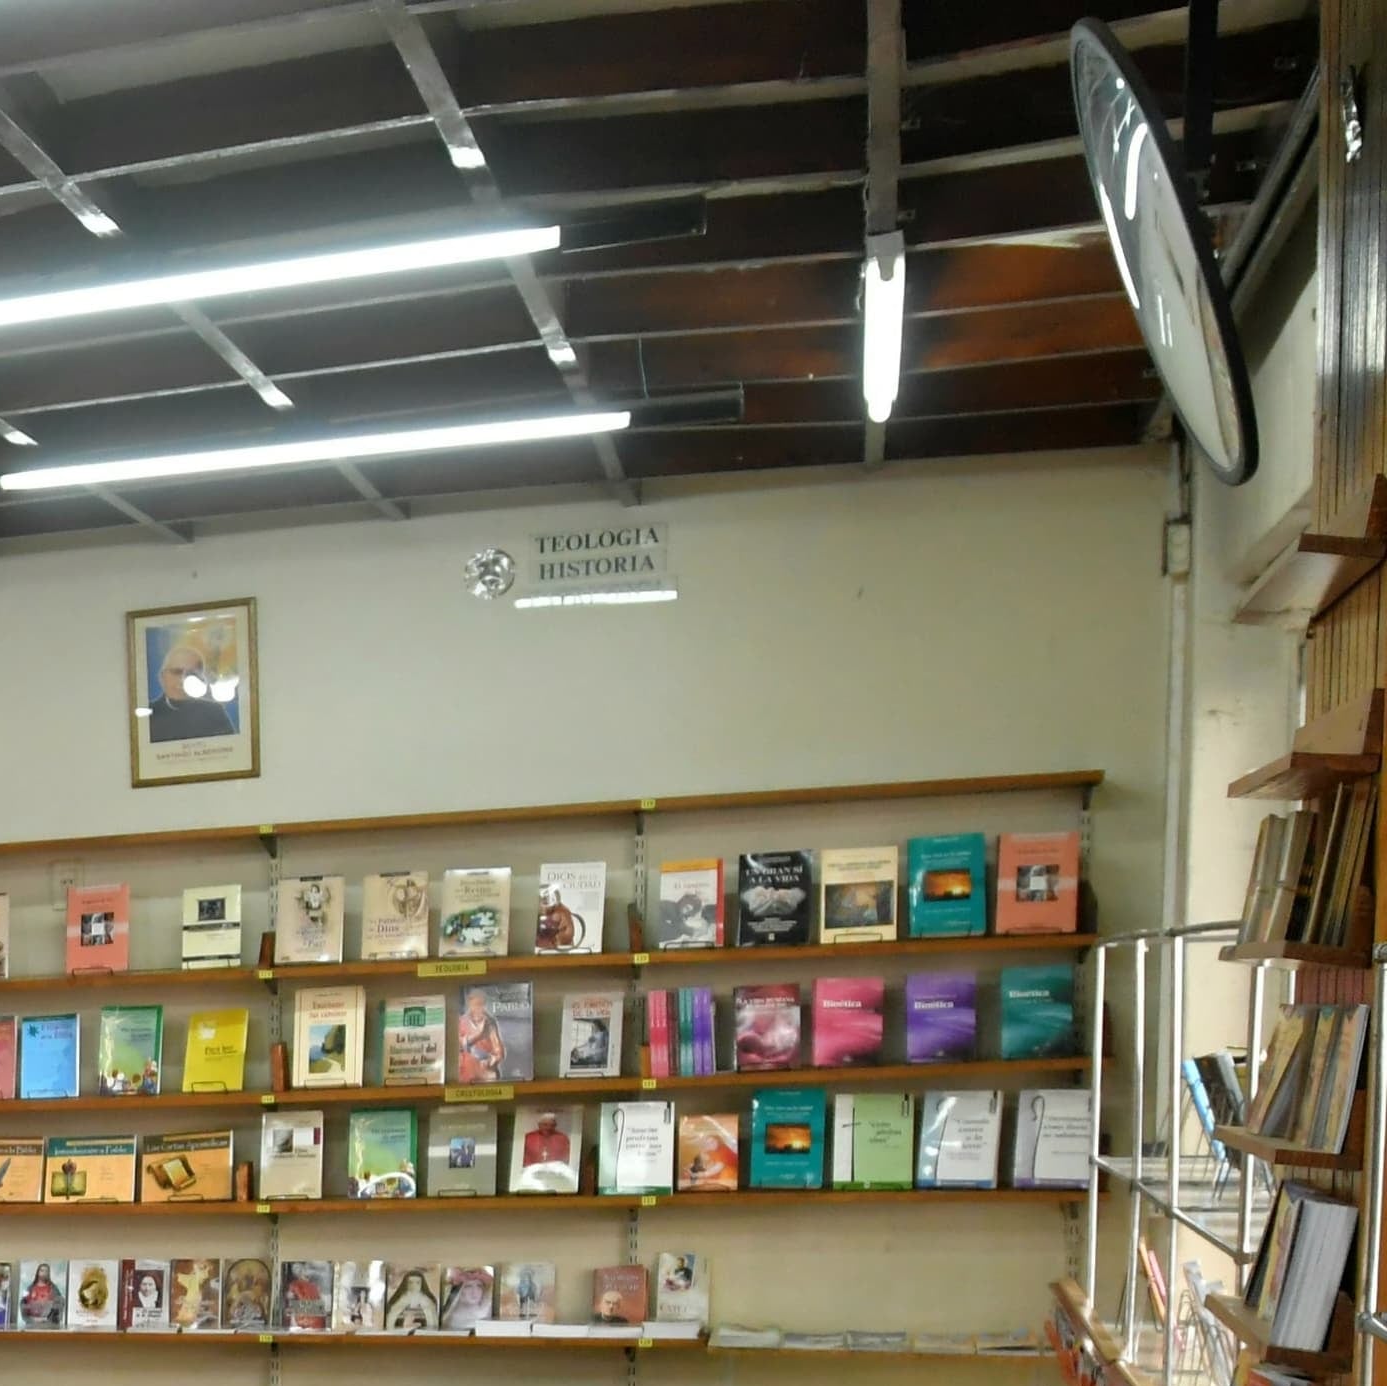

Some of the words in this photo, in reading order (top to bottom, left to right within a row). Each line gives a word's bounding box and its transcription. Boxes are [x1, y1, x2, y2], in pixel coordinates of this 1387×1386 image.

[535, 527, 660, 554] TEOLOGIA
[539, 554, 655, 580] HISTORIA
[491, 1001, 531, 1013] PABLO
